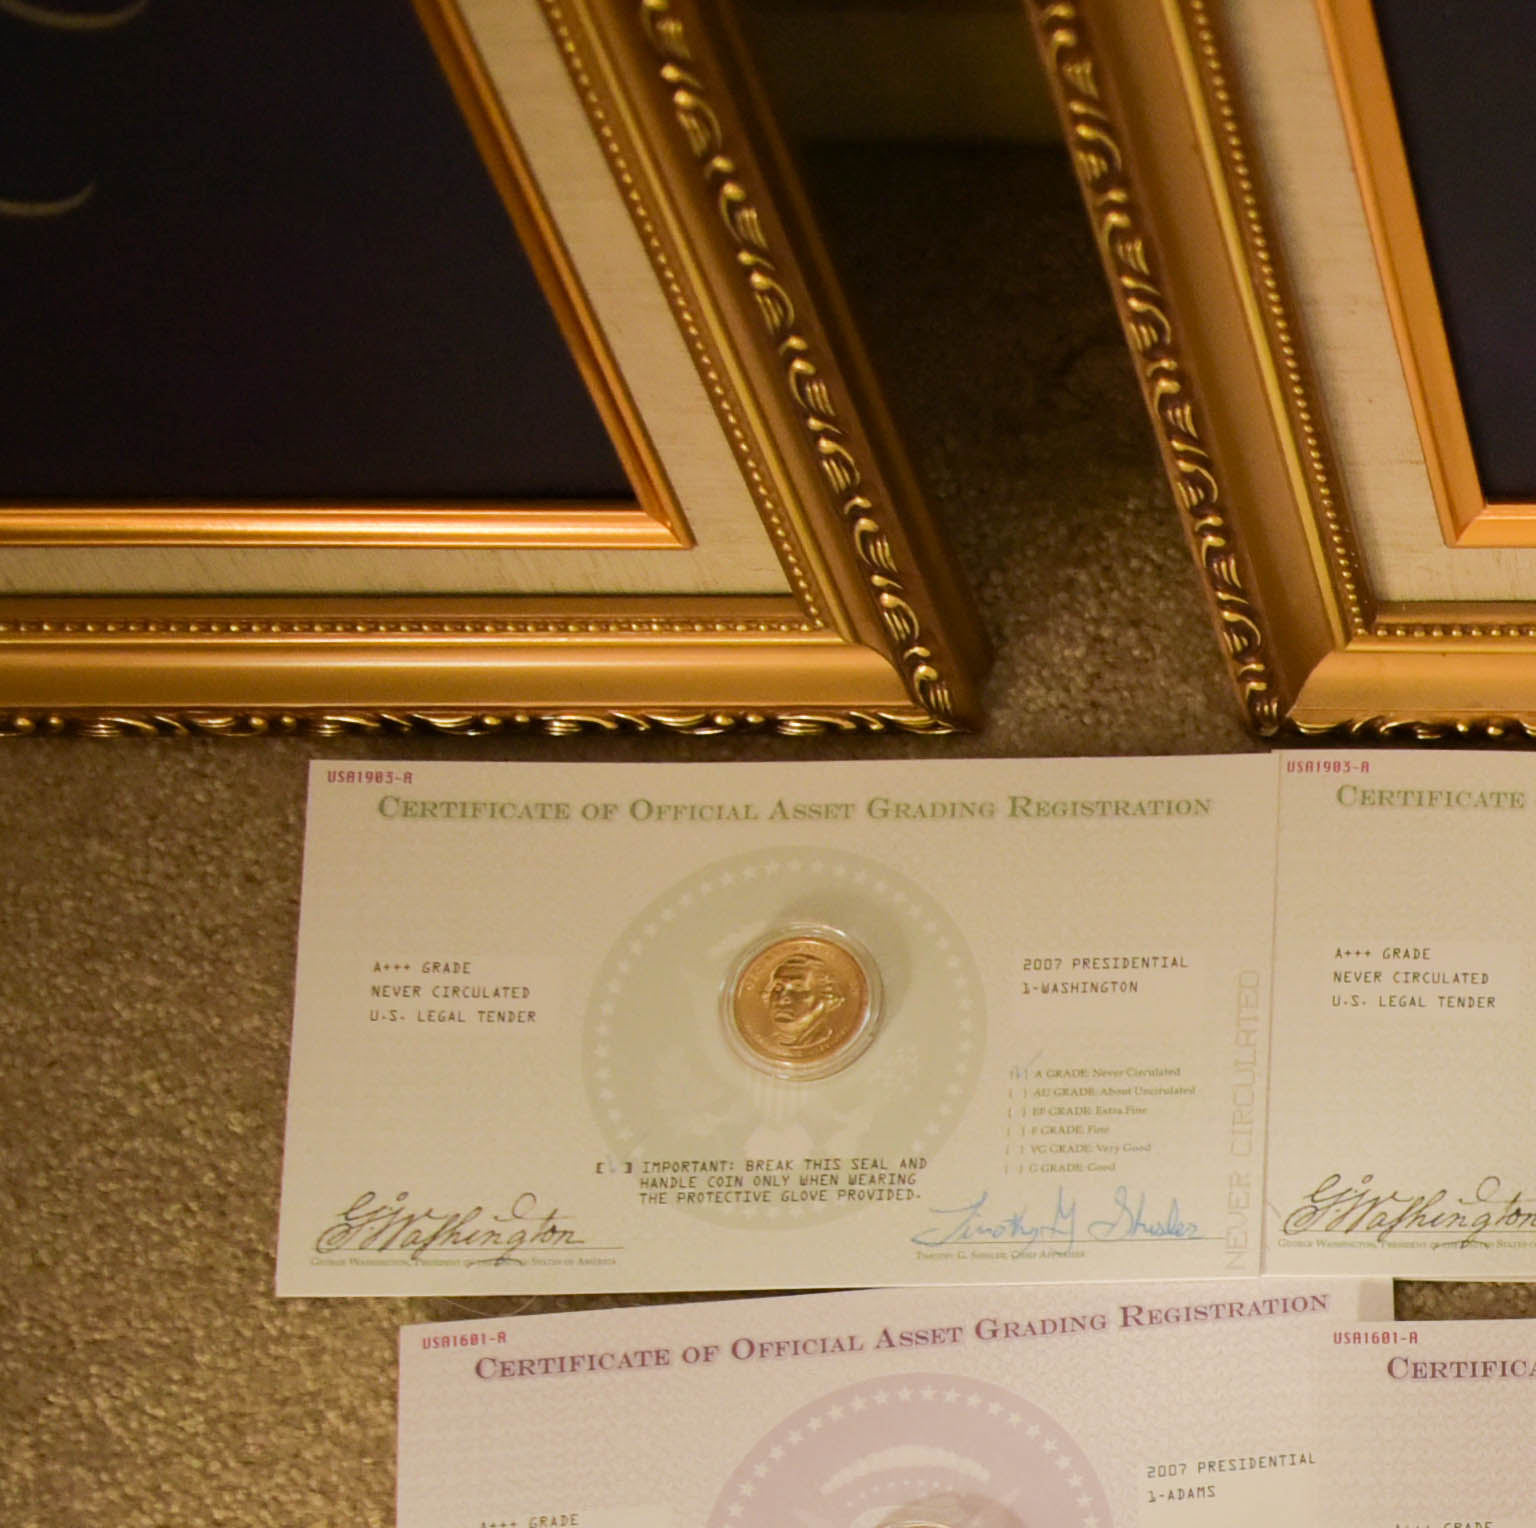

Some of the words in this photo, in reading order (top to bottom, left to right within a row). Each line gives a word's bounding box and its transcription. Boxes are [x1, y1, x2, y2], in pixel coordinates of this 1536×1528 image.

[1335, 783, 1525, 810] CERTIFICATE
[376, 794, 571, 821] CERTIFICATE
[580, 802, 620, 822] OF
[628, 797, 760, 823] OFFICIAL
[767, 798, 856, 822] ASSET
[865, 796, 997, 821] GRADING
[1007, 794, 1212, 819] REGISTRATION
[1022, 957, 1063, 971] 2007
[1071, 955, 1189, 970] PRESIDENTIAL
[370, 984, 422, 999] NEVER
[431, 984, 530, 1000] CIRCULATED
[1021, 980, 1138, 995] 1-WASHINGTON
[474, 1348, 671, 1380] CERTIFICATE
[680, 1344, 720, 1364] OF
[730, 1335, 865, 1361] OFFICIAL
[874, 1326, 964, 1350] ASSET
[974, 1314, 1107, 1341] GRADING
[1118, 1293, 1329, 1329] REGISTRATION
[1147, 1462, 1187, 1479] 2007
[1197, 1452, 1316, 1474] PRESIDENTIAL
[1148, 1484, 1216, 1504] 1-ADAMS
